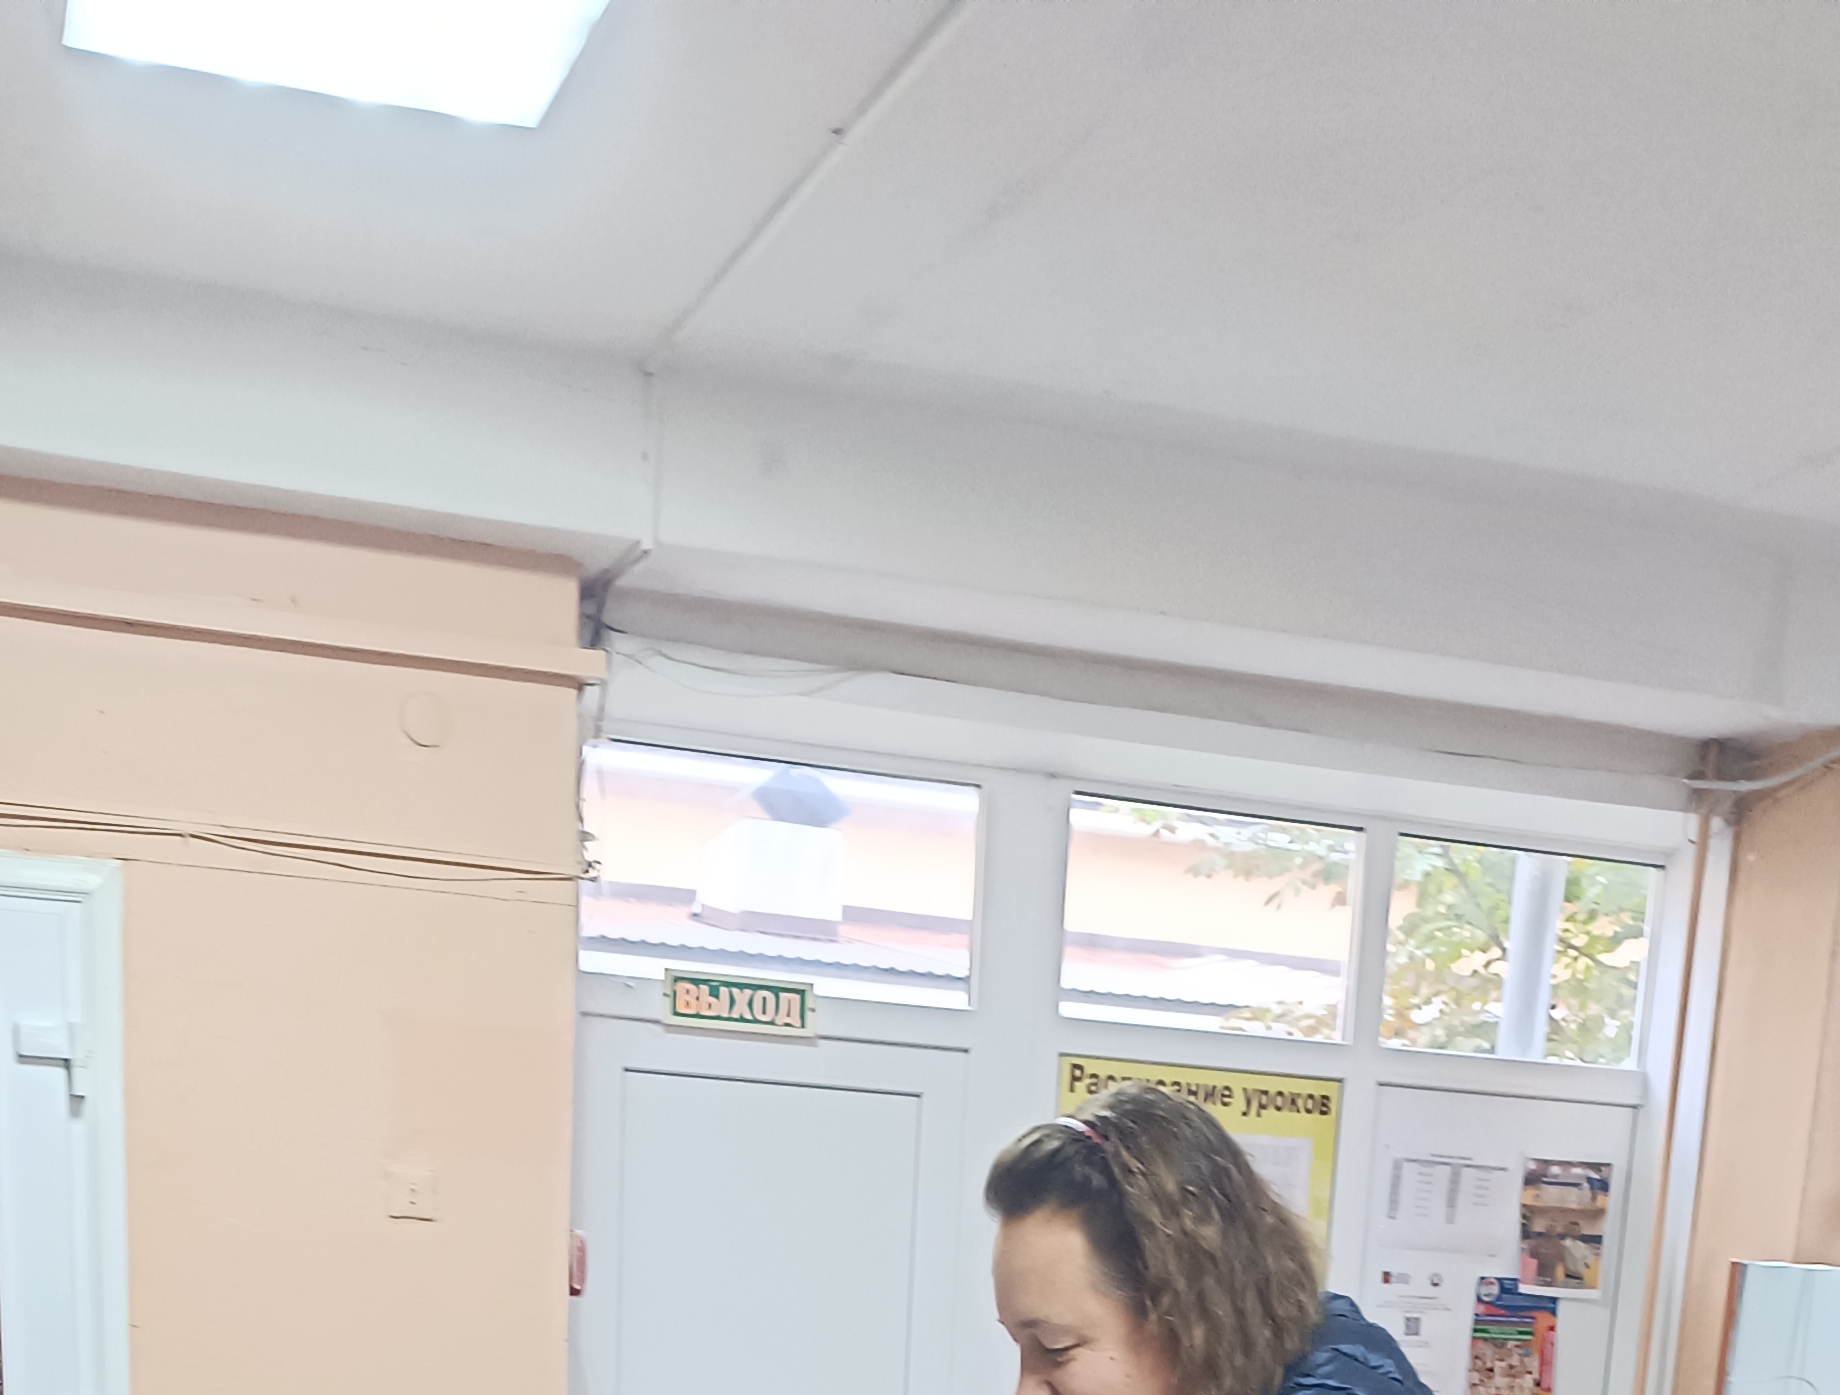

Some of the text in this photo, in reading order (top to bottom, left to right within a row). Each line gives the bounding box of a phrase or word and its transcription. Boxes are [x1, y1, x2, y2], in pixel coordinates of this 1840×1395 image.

[674, 980, 802, 1029] ВЫХОД
[1067, 1062, 1332, 1118] Расание уроков
